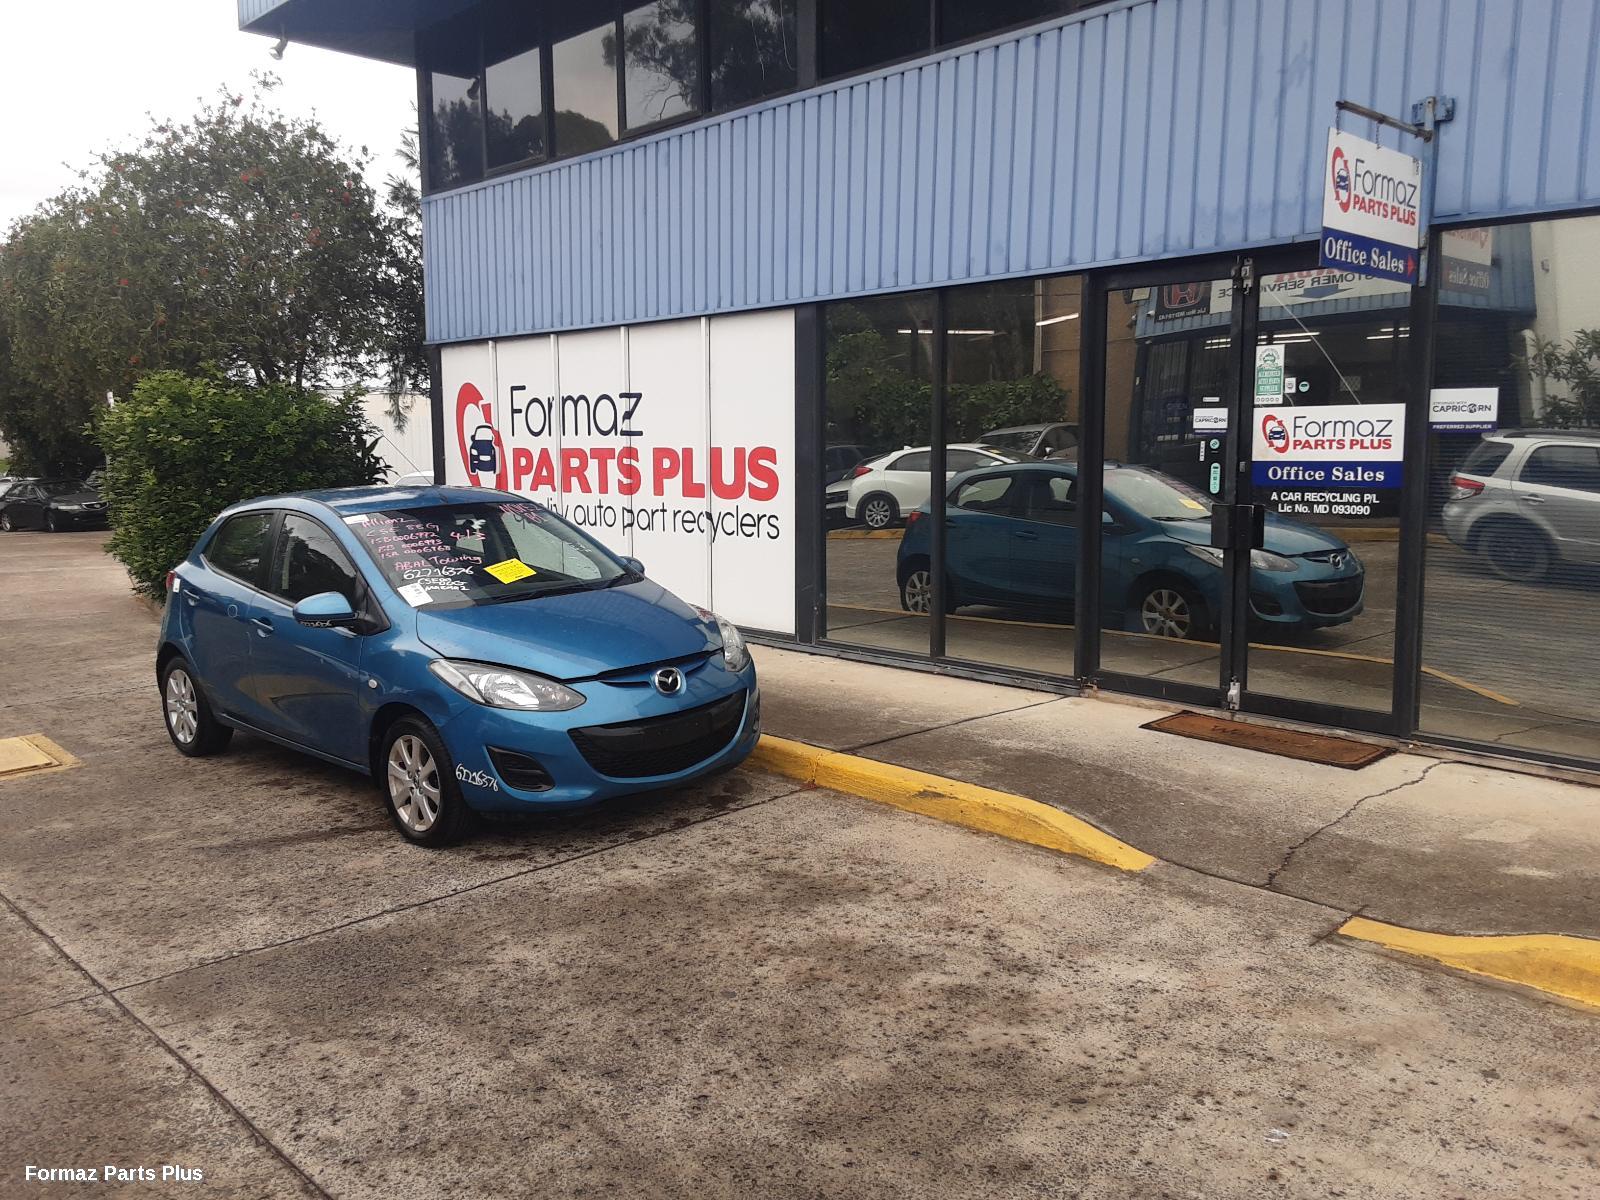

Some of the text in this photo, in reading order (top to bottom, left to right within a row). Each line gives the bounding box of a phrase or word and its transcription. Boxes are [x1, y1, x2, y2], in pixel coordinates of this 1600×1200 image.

[1353, 158, 1418, 210] Formaz
[1353, 195, 1417, 227] PARTS PLUS
[1325, 236, 1405, 274] Office Sales
[511, 384, 644, 437] Formaz
[1293, 415, 1393, 438] Formaz
[1293, 438, 1392, 450] PARTS PLUS
[512, 446, 780, 502] PARTS PLUS
[1268, 466, 1385, 481] Office Sales
[1270, 491, 1380, 504] A CAR RECYCLING P/L
[1278, 503, 1371, 515] Lic No. MD 093090
[573, 498, 616, 527] auto
[622, 502, 668, 537] part
[673, 504, 781, 544] recyclers
